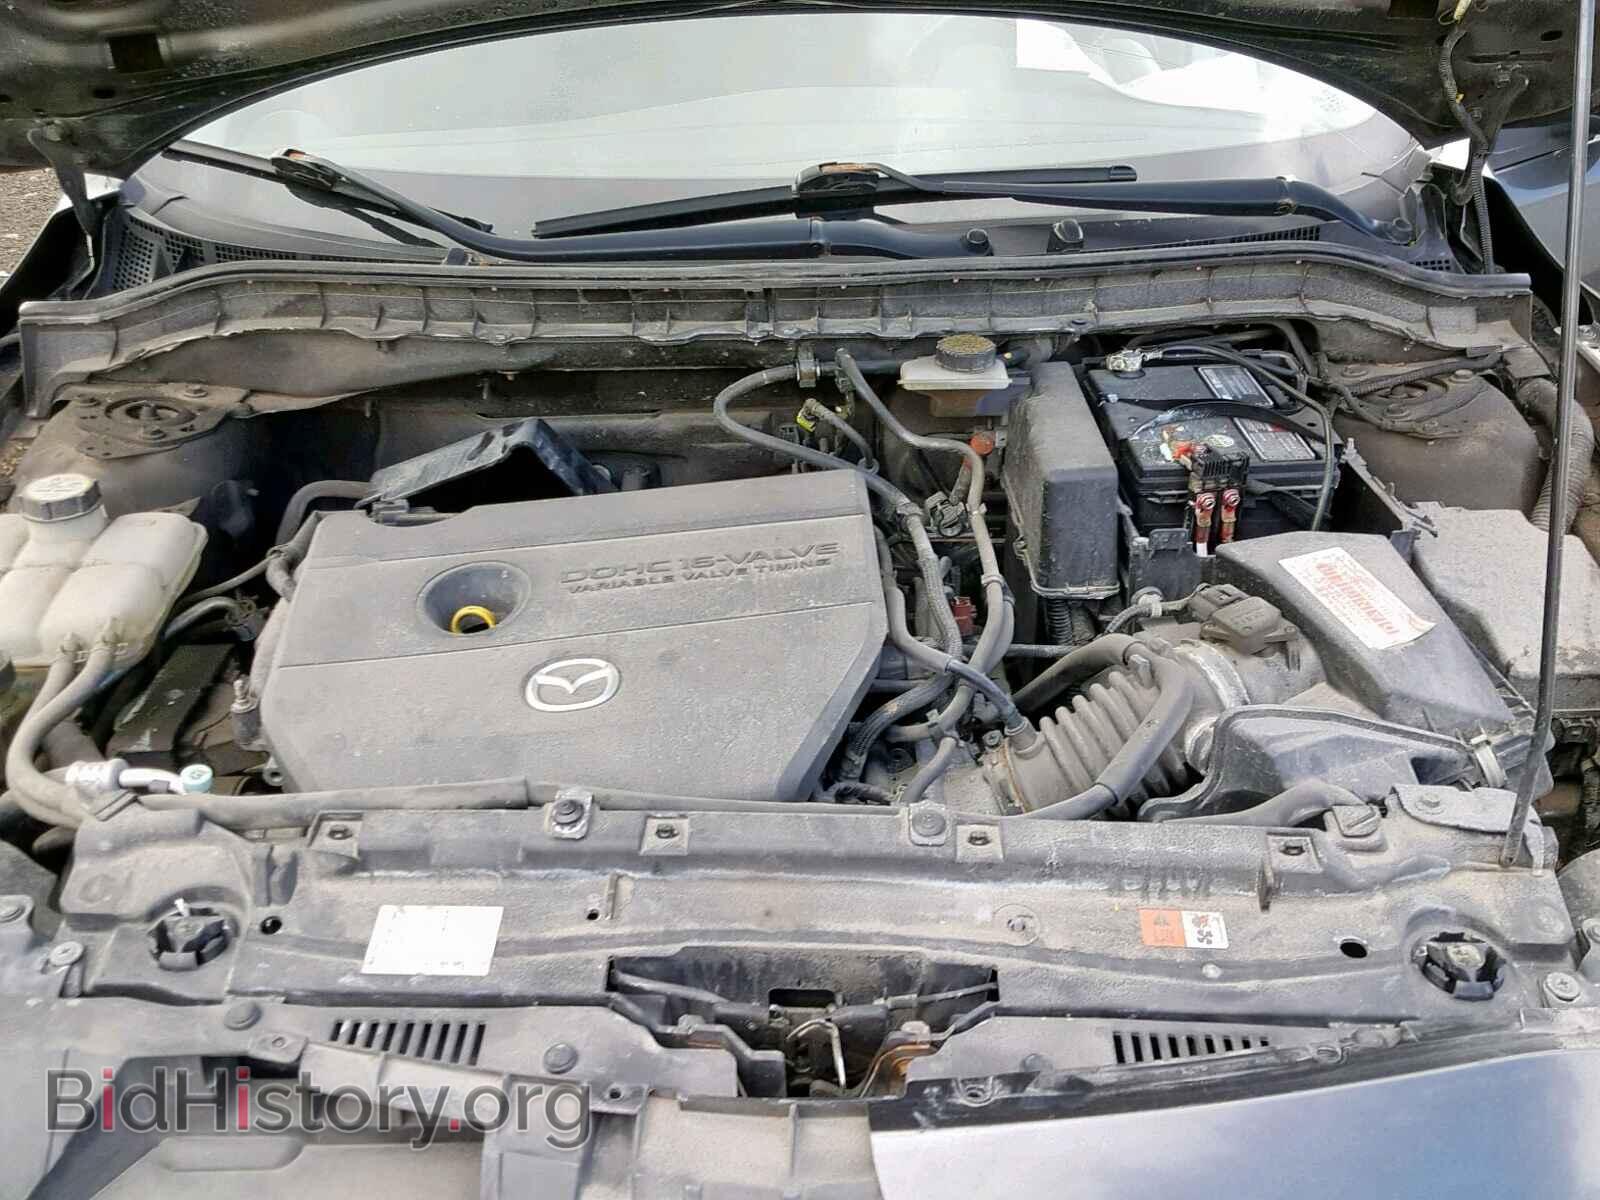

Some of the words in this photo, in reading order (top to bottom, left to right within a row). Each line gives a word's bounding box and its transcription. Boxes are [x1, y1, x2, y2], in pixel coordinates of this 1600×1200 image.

[560, 560, 672, 583] DOHC
[679, 542, 839, 570] 16-VALVE
[569, 575, 675, 594] VARIABLE
[684, 567, 748, 581] VALVE
[754, 558, 831, 574] TIMING
